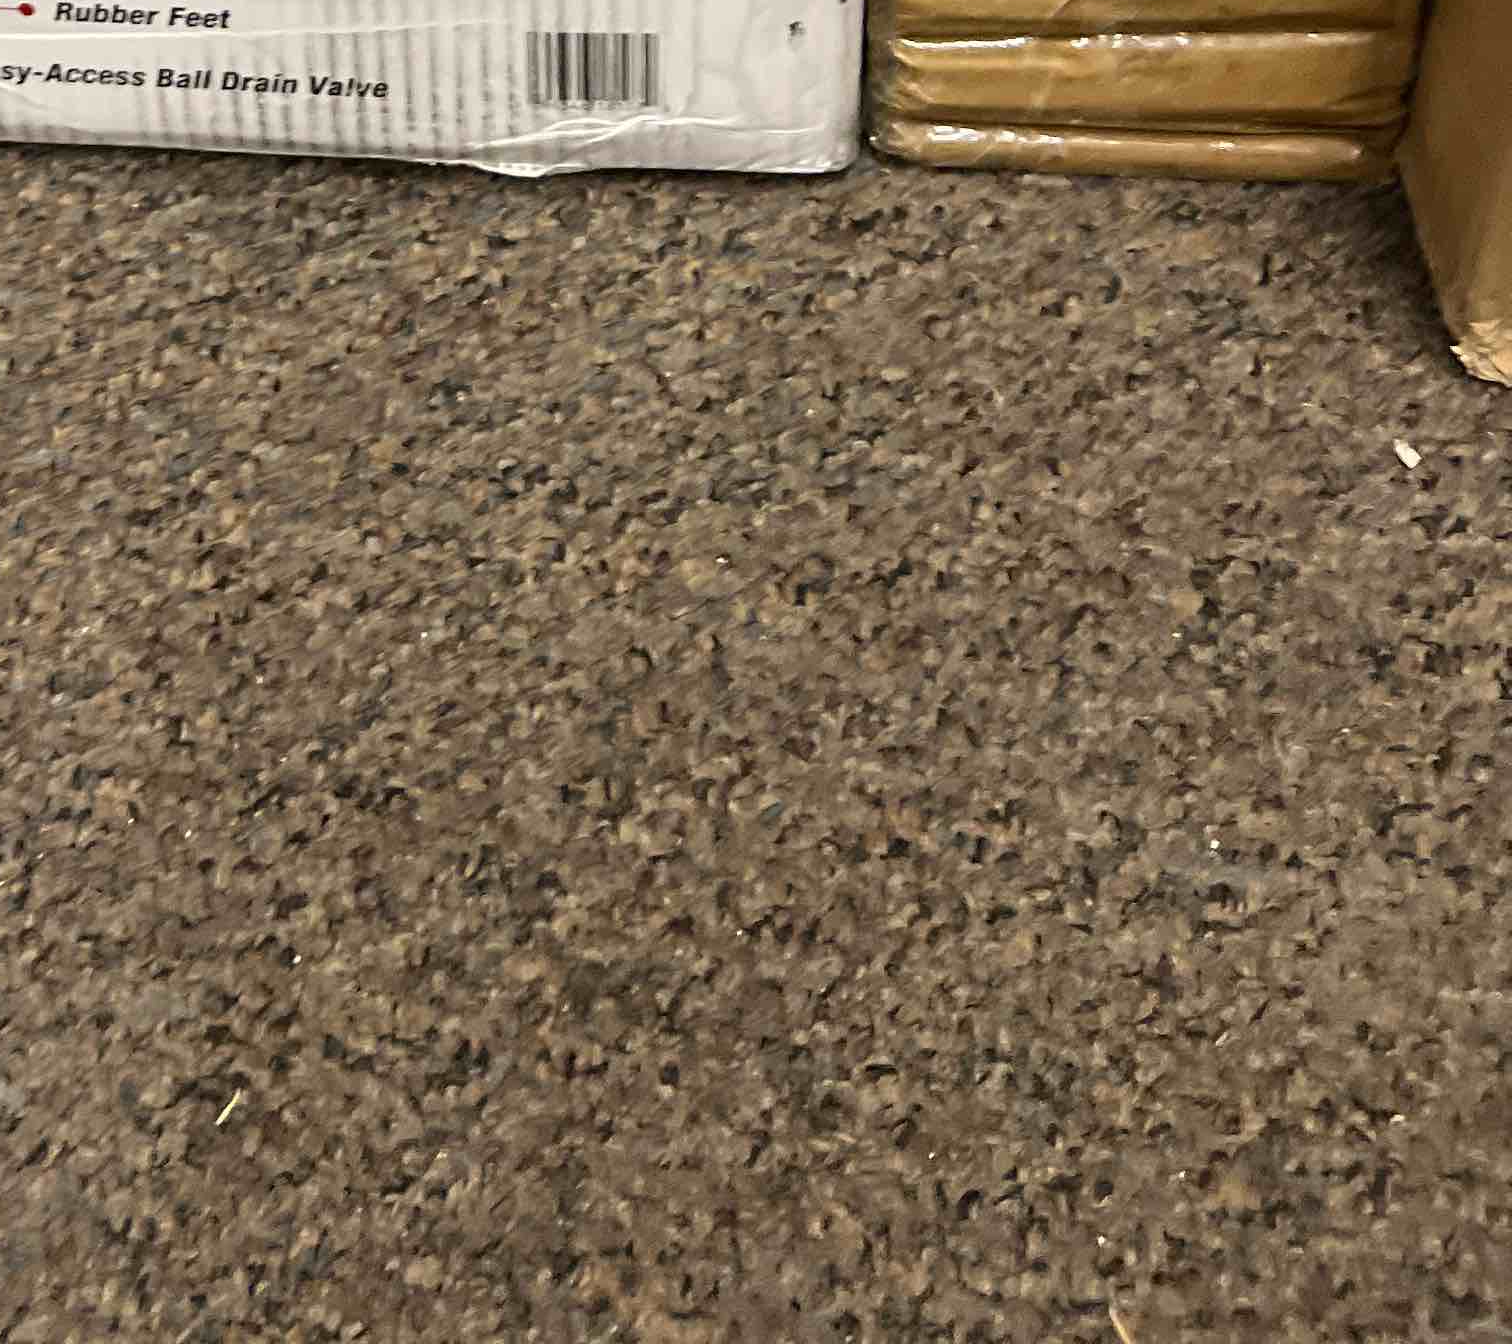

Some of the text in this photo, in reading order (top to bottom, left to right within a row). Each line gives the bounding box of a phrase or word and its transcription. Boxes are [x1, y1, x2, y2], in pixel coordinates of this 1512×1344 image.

[54, 1, 231, 29] Rubber Feet
[155, 68, 212, 89] Ball
[220, 71, 298, 94] Drain
[309, 75, 389, 99] Valve
